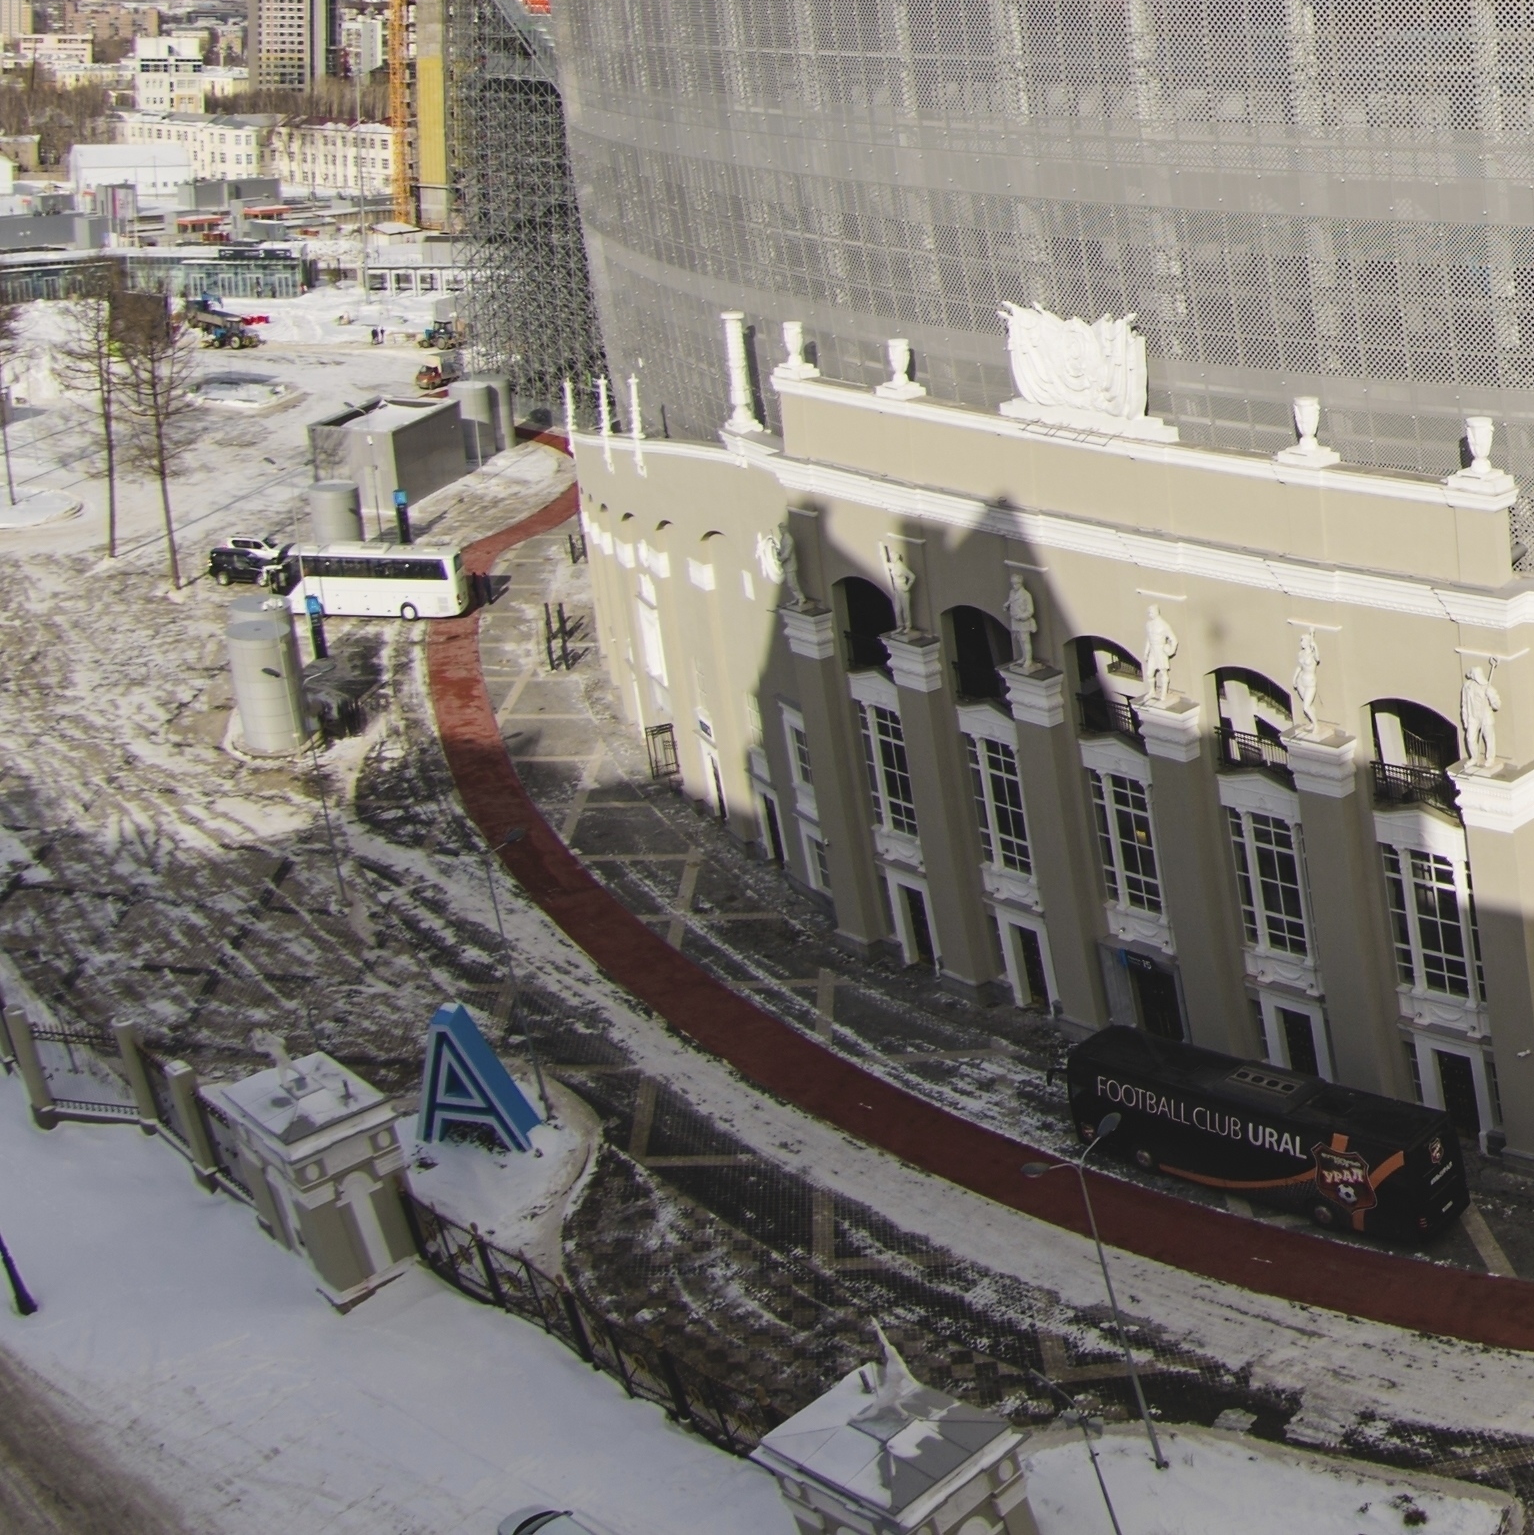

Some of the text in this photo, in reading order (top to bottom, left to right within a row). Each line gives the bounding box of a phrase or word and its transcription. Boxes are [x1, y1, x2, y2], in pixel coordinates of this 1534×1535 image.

[416, 1005, 540, 1152] A
[1097, 1075, 1308, 1159] FOOTBALL CLUB URAL
[1322, 1168, 1364, 1183] УРАЛ
